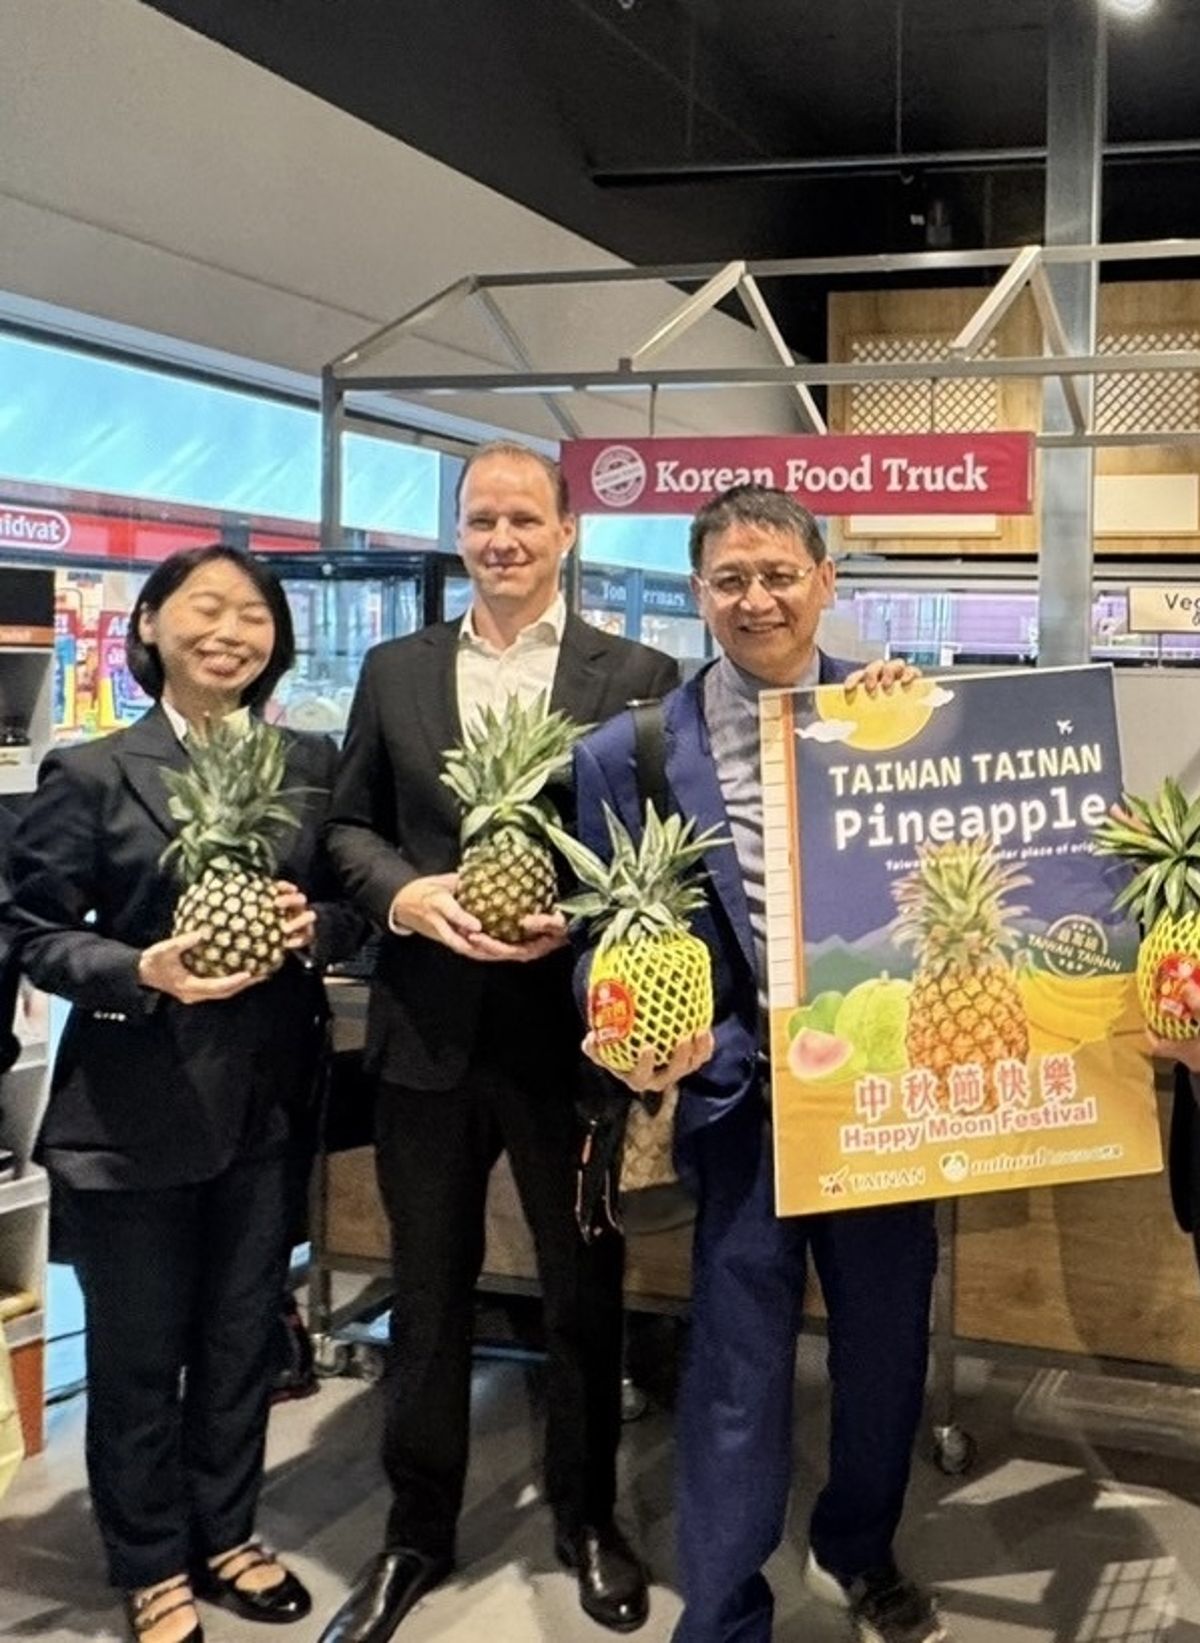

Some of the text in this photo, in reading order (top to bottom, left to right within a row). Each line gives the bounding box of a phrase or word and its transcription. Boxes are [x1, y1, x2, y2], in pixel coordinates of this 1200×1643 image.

[655, 460, 774, 492] Korean
[785, 455, 871, 492] Food
[884, 454, 988, 491] Truck
[0, 513, 60, 541] idvat
[828, 743, 1102, 796] TAIWAN TAINAN
[835, 787, 1106, 850] Pineapple
[1028, 934, 1074, 957] TAIWAN
[1077, 949, 1121, 972] TAINAN
[859, 1057, 1076, 1117] 中秋節快樂
[843, 1102, 1095, 1154] Happy Moon Festival
